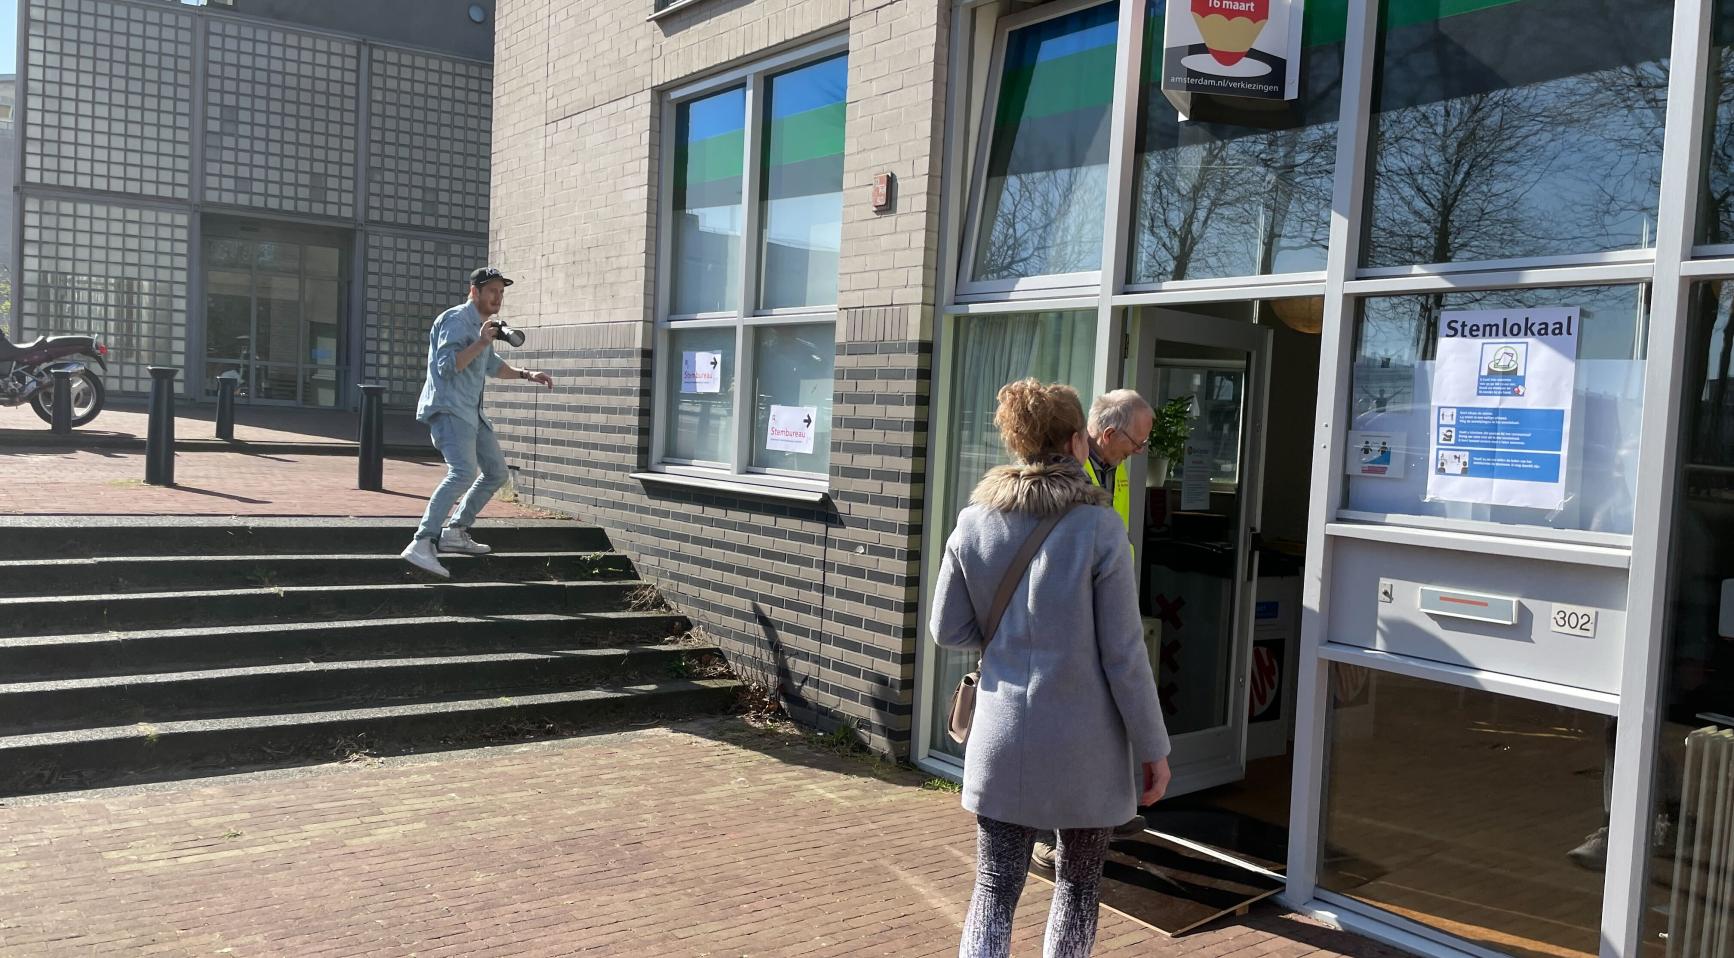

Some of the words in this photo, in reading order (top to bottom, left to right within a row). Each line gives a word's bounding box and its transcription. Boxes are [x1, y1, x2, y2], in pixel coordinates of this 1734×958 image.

[1208, 0, 1220, 8] 16
[1222, 0, 1255, 12] maart
[1170, 76, 1279, 92] amsterdam.nl/verkiezingen
[1445, 315, 1573, 338] Stemlokaal
[770, 426, 806, 438] Stembureau
[1554, 610, 1591, 632] 302
